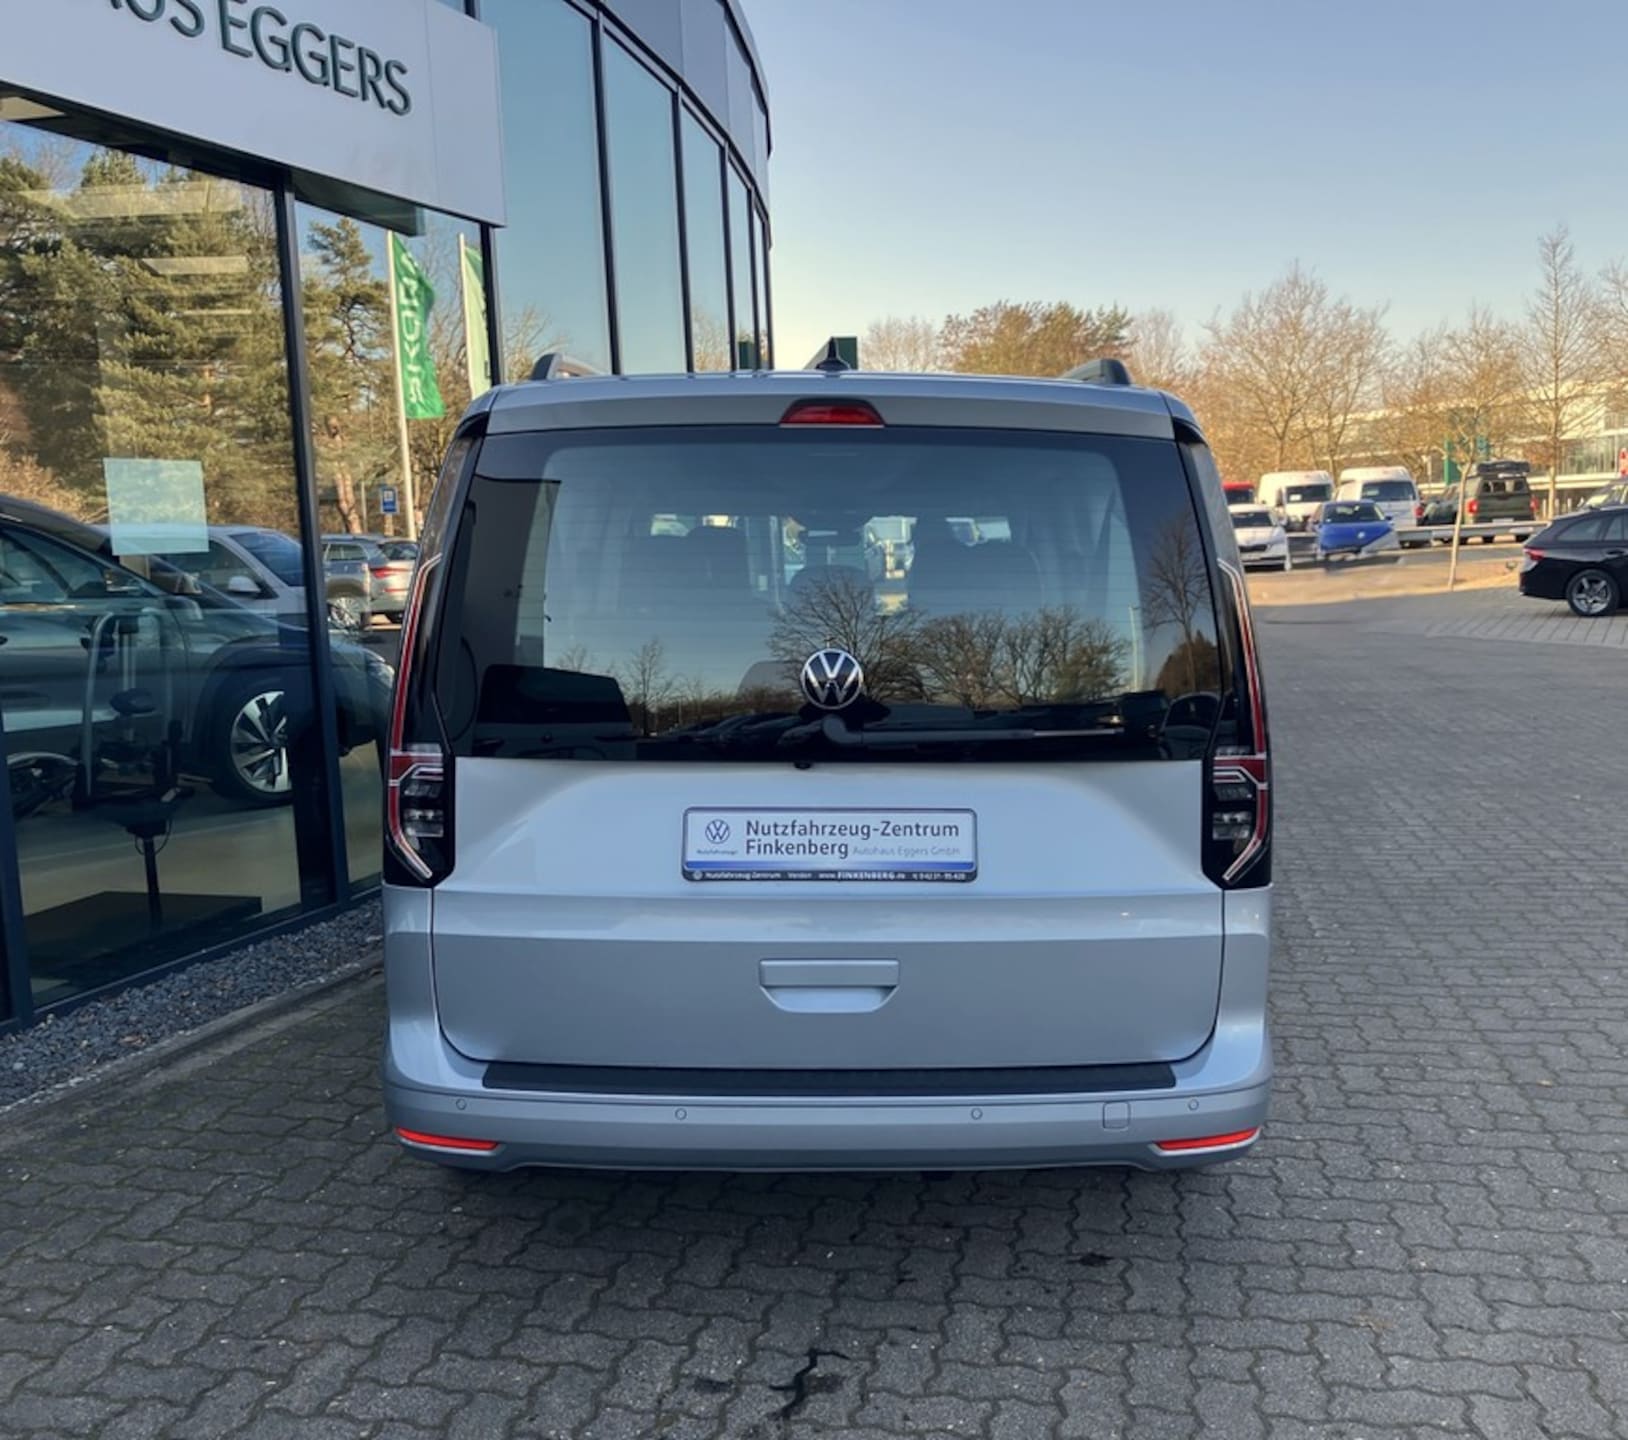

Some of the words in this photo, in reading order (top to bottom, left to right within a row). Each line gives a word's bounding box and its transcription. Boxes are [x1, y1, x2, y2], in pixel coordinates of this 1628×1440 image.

[217, 0, 412, 116] EGGERS
[746, 820, 959, 841] Nutzfahrzeug-Zentrum
[746, 839, 849, 860] Finkenberg
